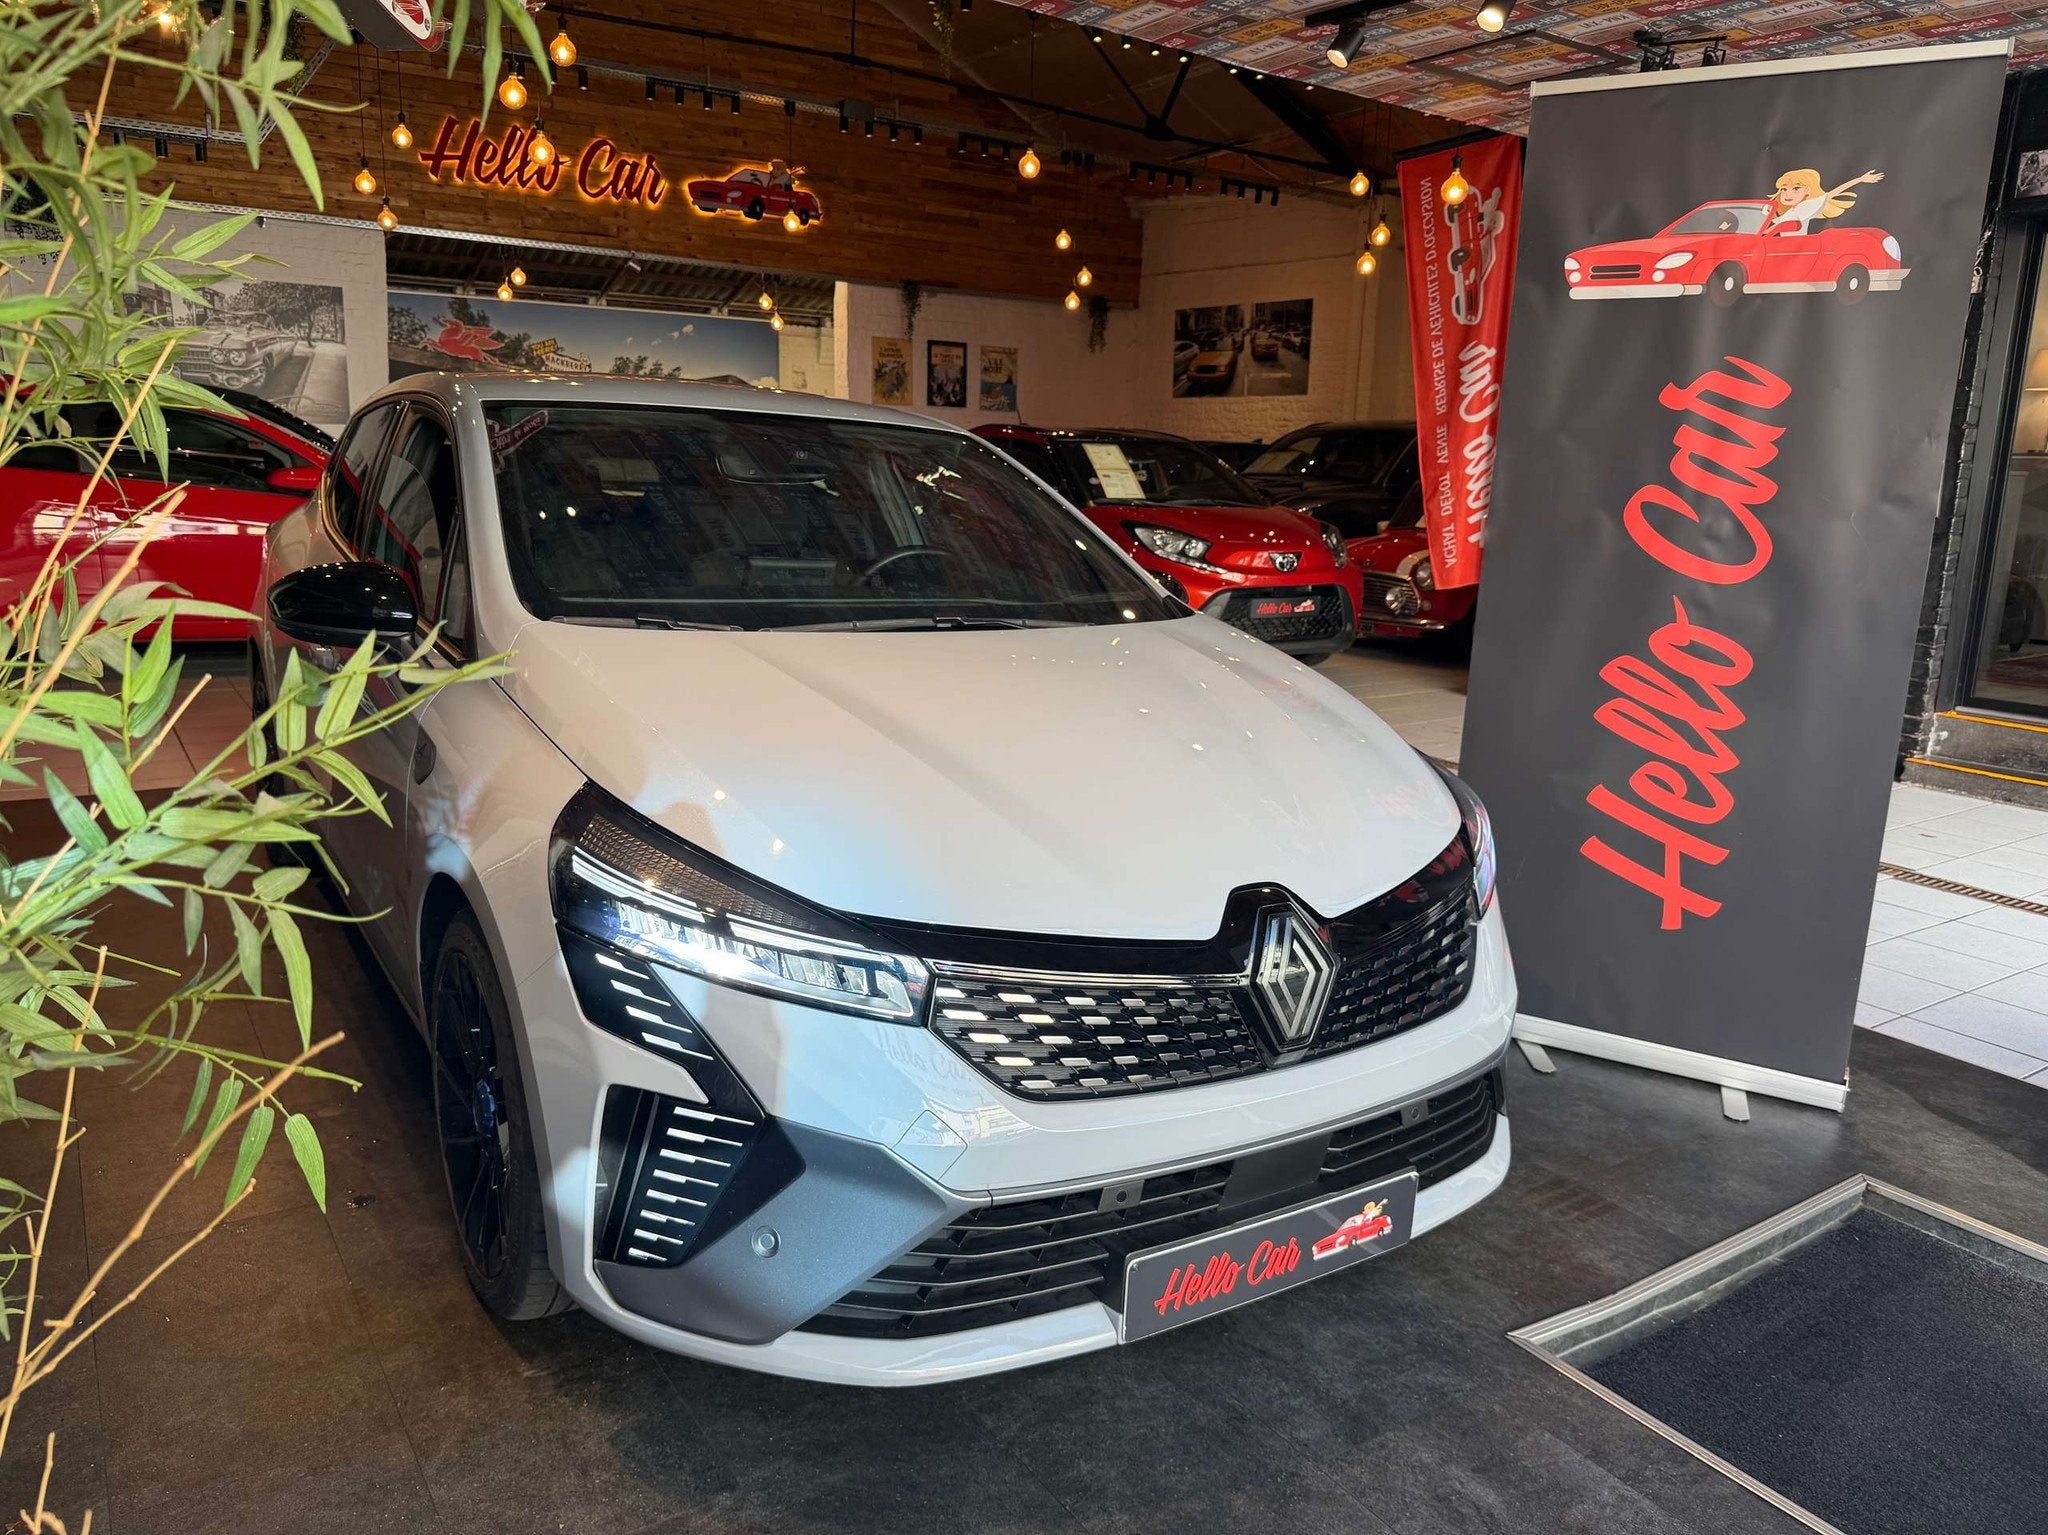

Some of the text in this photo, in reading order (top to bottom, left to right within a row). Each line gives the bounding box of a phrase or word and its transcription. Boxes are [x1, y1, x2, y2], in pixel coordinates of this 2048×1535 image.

[418, 116, 667, 205] Hello Car
[1581, 356, 1792, 930] Hello Car
[1154, 1236, 1301, 1316] Hello Car
